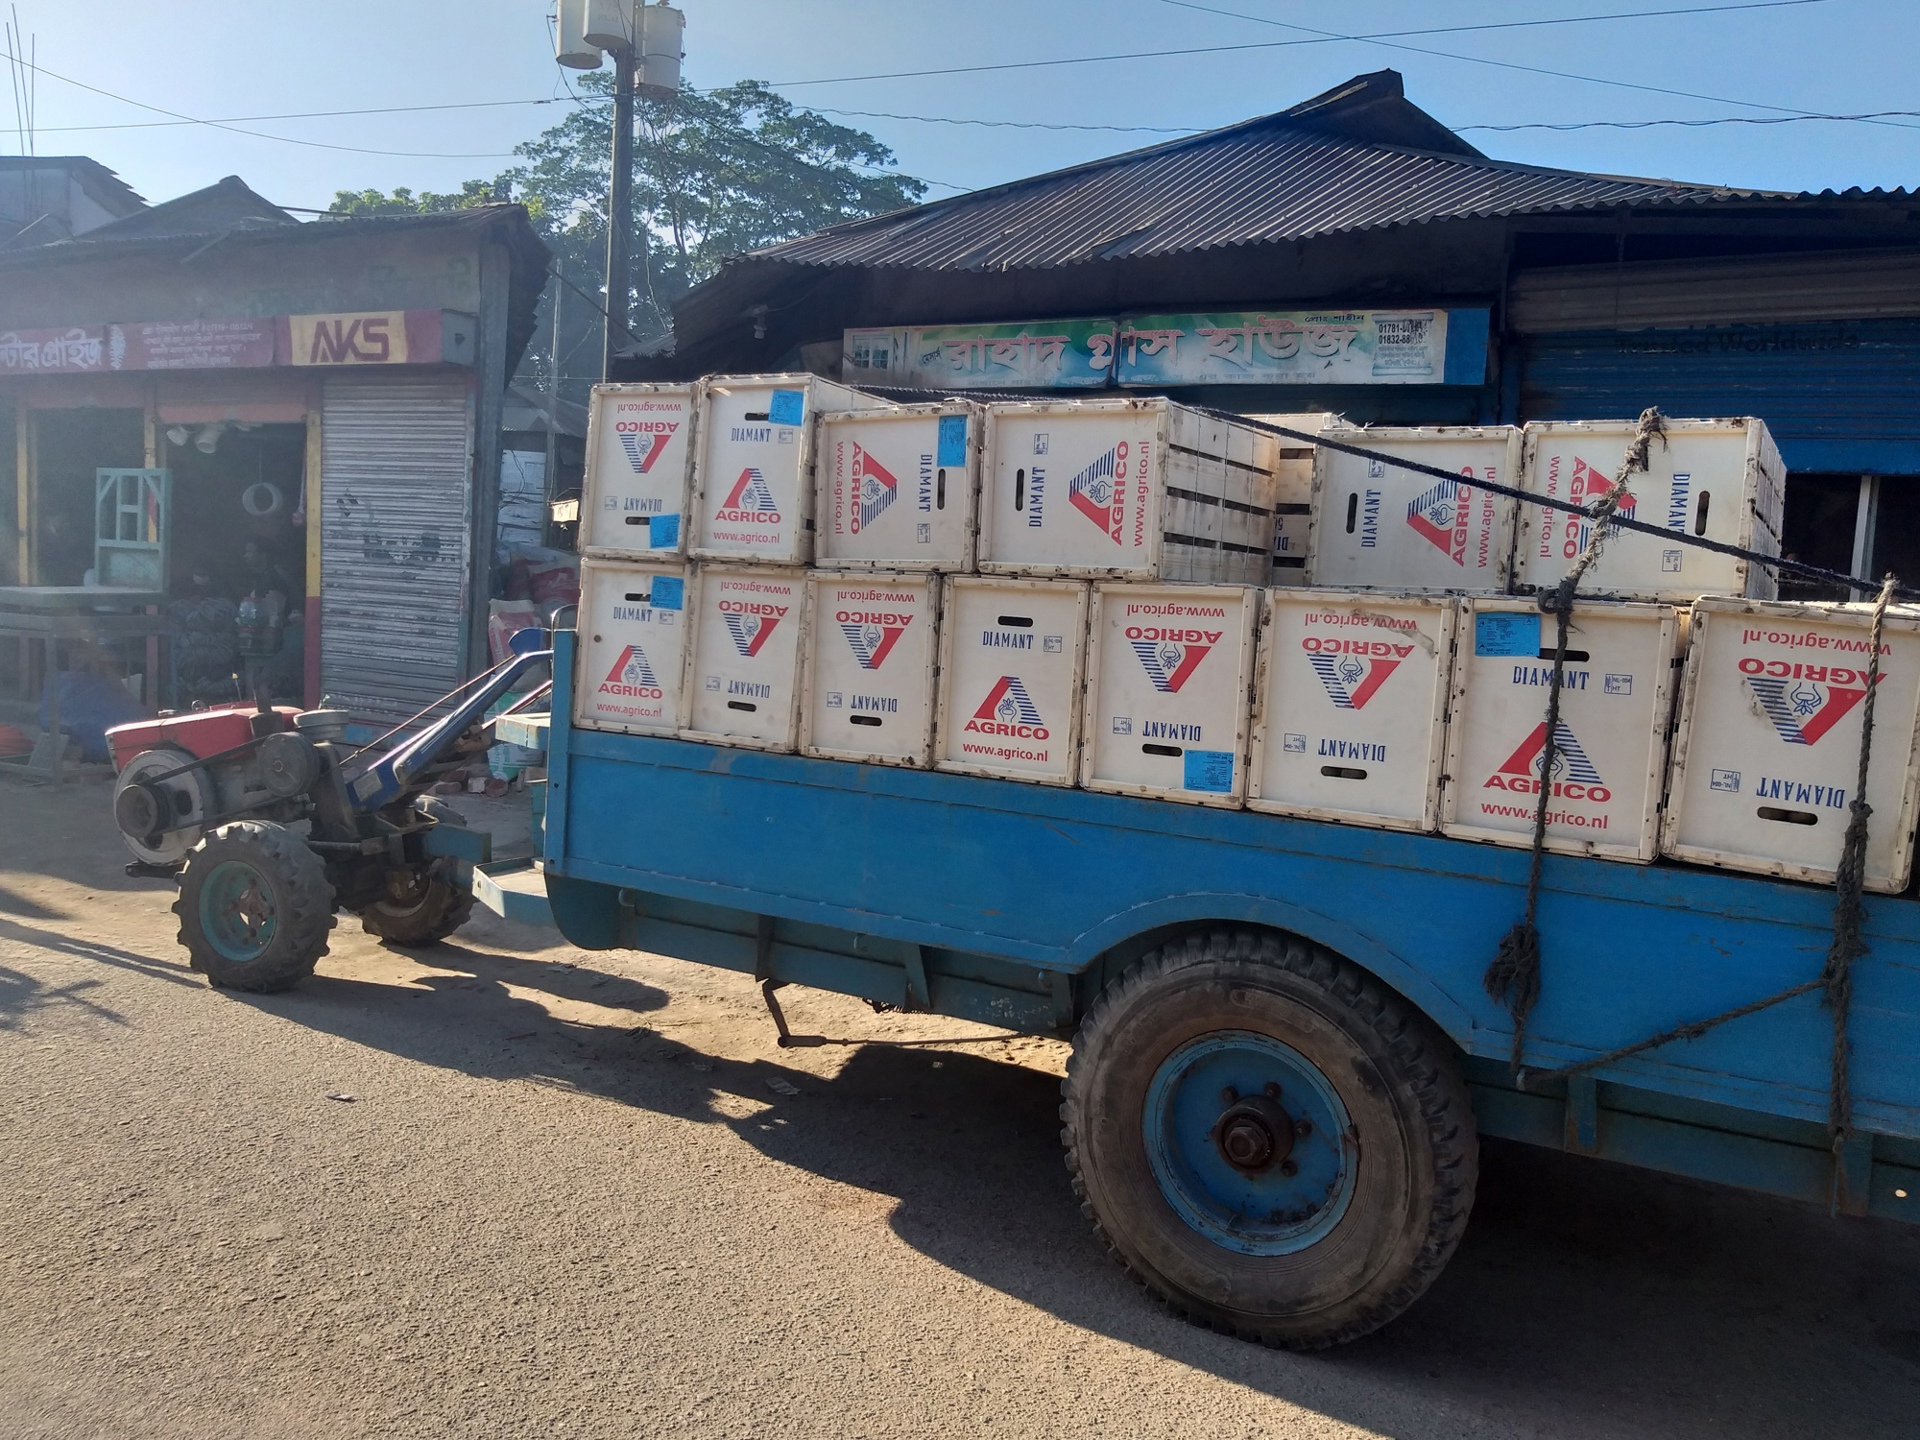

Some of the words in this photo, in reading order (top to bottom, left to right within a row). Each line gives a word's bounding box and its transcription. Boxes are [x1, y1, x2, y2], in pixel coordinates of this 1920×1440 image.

[1087, 326, 1184, 371] গ্লাস
[617, 398, 682, 411] www.agrico.nl
[615, 421, 680, 435] AGRICO
[731, 427, 772, 443] DIAMANT
[832, 442, 845, 535] www.agrico.nl
[850, 442, 864, 535] AGRICO
[918, 454, 933, 513] DIAMANT
[1108, 441, 1129, 545] AGRICO
[1028, 466, 1046, 528] DIAMANT
[1134, 441, 1150, 548] www.agrico.nl
[623, 497, 663, 513] DIAMANT
[1539, 455, 1561, 559] www.grico.nl
[715, 507, 781, 524] AGRICO
[1360, 489, 1381, 548] DIAMANT
[1478, 466, 1497, 568] www.agric.nl
[713, 531, 781, 544] www.agrico.nl
[720, 578, 794, 595] www.agrico.nl
[837, 588, 915, 602] www.agrico.nl
[613, 603, 654, 623] DIAMANT
[718, 600, 788, 618] AGRICO
[1126, 601, 1225, 617] www.agrico.nl
[835, 611, 913, 628] AGRICO
[1305, 610, 1418, 630] www.agrico.nl
[982, 630, 1034, 650] DIAMANT
[1124, 626, 1223, 645] AGRICO
[1301, 636, 1415, 661] AGRICO
[598, 681, 663, 701] AGRICO
[727, 679, 771, 699] DIAMANT
[596, 703, 662, 717] www.agrico.nl
[850, 694, 898, 713] DIAMANT
[963, 717, 1050, 741] AGRICO
[1142, 720, 1202, 742] DIAMANT
[962, 742, 1049, 762] www.agrico.nl
[1317, 738, 1386, 763] DIAMANT
[1755, 777, 1846, 812] DIAMANT
